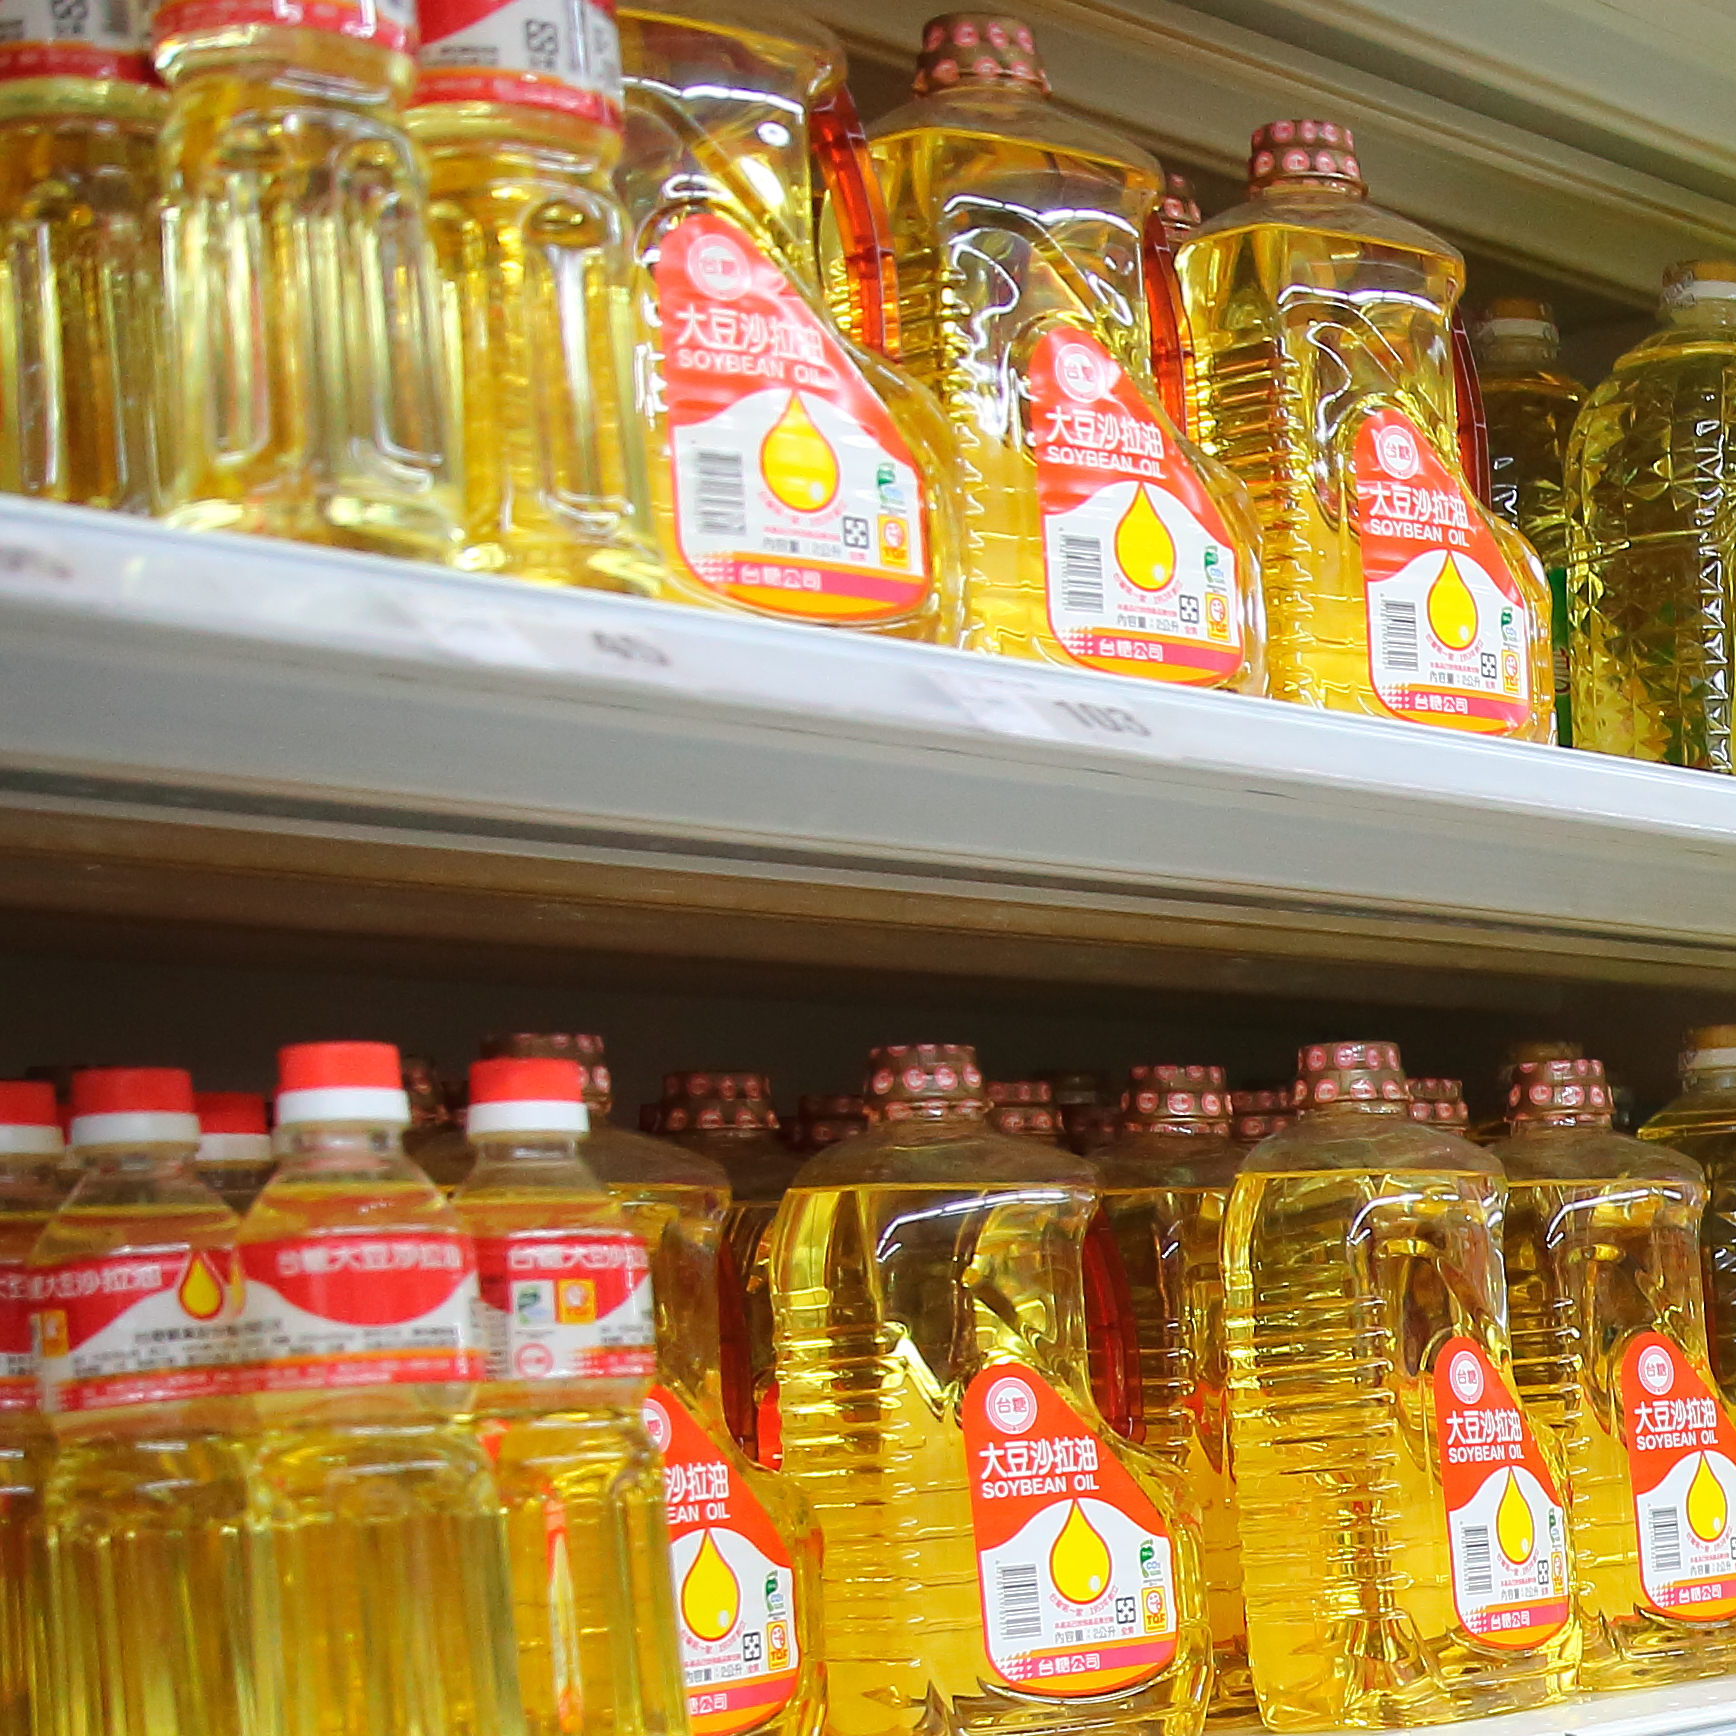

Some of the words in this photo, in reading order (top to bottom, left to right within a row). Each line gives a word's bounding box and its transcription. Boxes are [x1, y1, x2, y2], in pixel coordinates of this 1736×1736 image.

[677, 304, 824, 367] 大豆沙拉油
[678, 351, 785, 379] SOYBEAN
[795, 366, 837, 383] OIL
[1046, 409, 1164, 460] 大豆沙拉油
[1046, 446, 1132, 473] SOYBEAN
[1138, 458, 1166, 480] OIL
[1369, 483, 1470, 531] 大豆沙拉油
[1370, 518, 1443, 544] SOYBEAN
[1447, 527, 1470, 549] OIL
[1099, 638, 1164, 662] 台糖公司
[1413, 692, 1469, 716] 台糖公司
[1645, 1363, 1667, 1378] 台糖
[996, 1396, 1027, 1415] 台糖
[1634, 1396, 1717, 1434] 大豆沙拉油
[1446, 1407, 1523, 1446] 大豆沙拉油
[1636, 1432, 1697, 1450] SOYBEAN
[1701, 1430, 1718, 1445] OIL
[979, 1438, 1099, 1481] 大豆沙拉油
[1448, 1445, 1505, 1463] SOYBEAN
[1508, 1444, 1525, 1459] OIL
[982, 1474, 1067, 1500] SOYBEAN
[1073, 1472, 1099, 1492] OIL
[705, 1501, 731, 1521] OIL
[1678, 1585, 1722, 1604] 台糖公司
[1146, 1613, 1165, 1625] TQF
[1490, 1611, 1531, 1629] 台糖公司
[1039, 1652, 1101, 1677] 台糖公司
